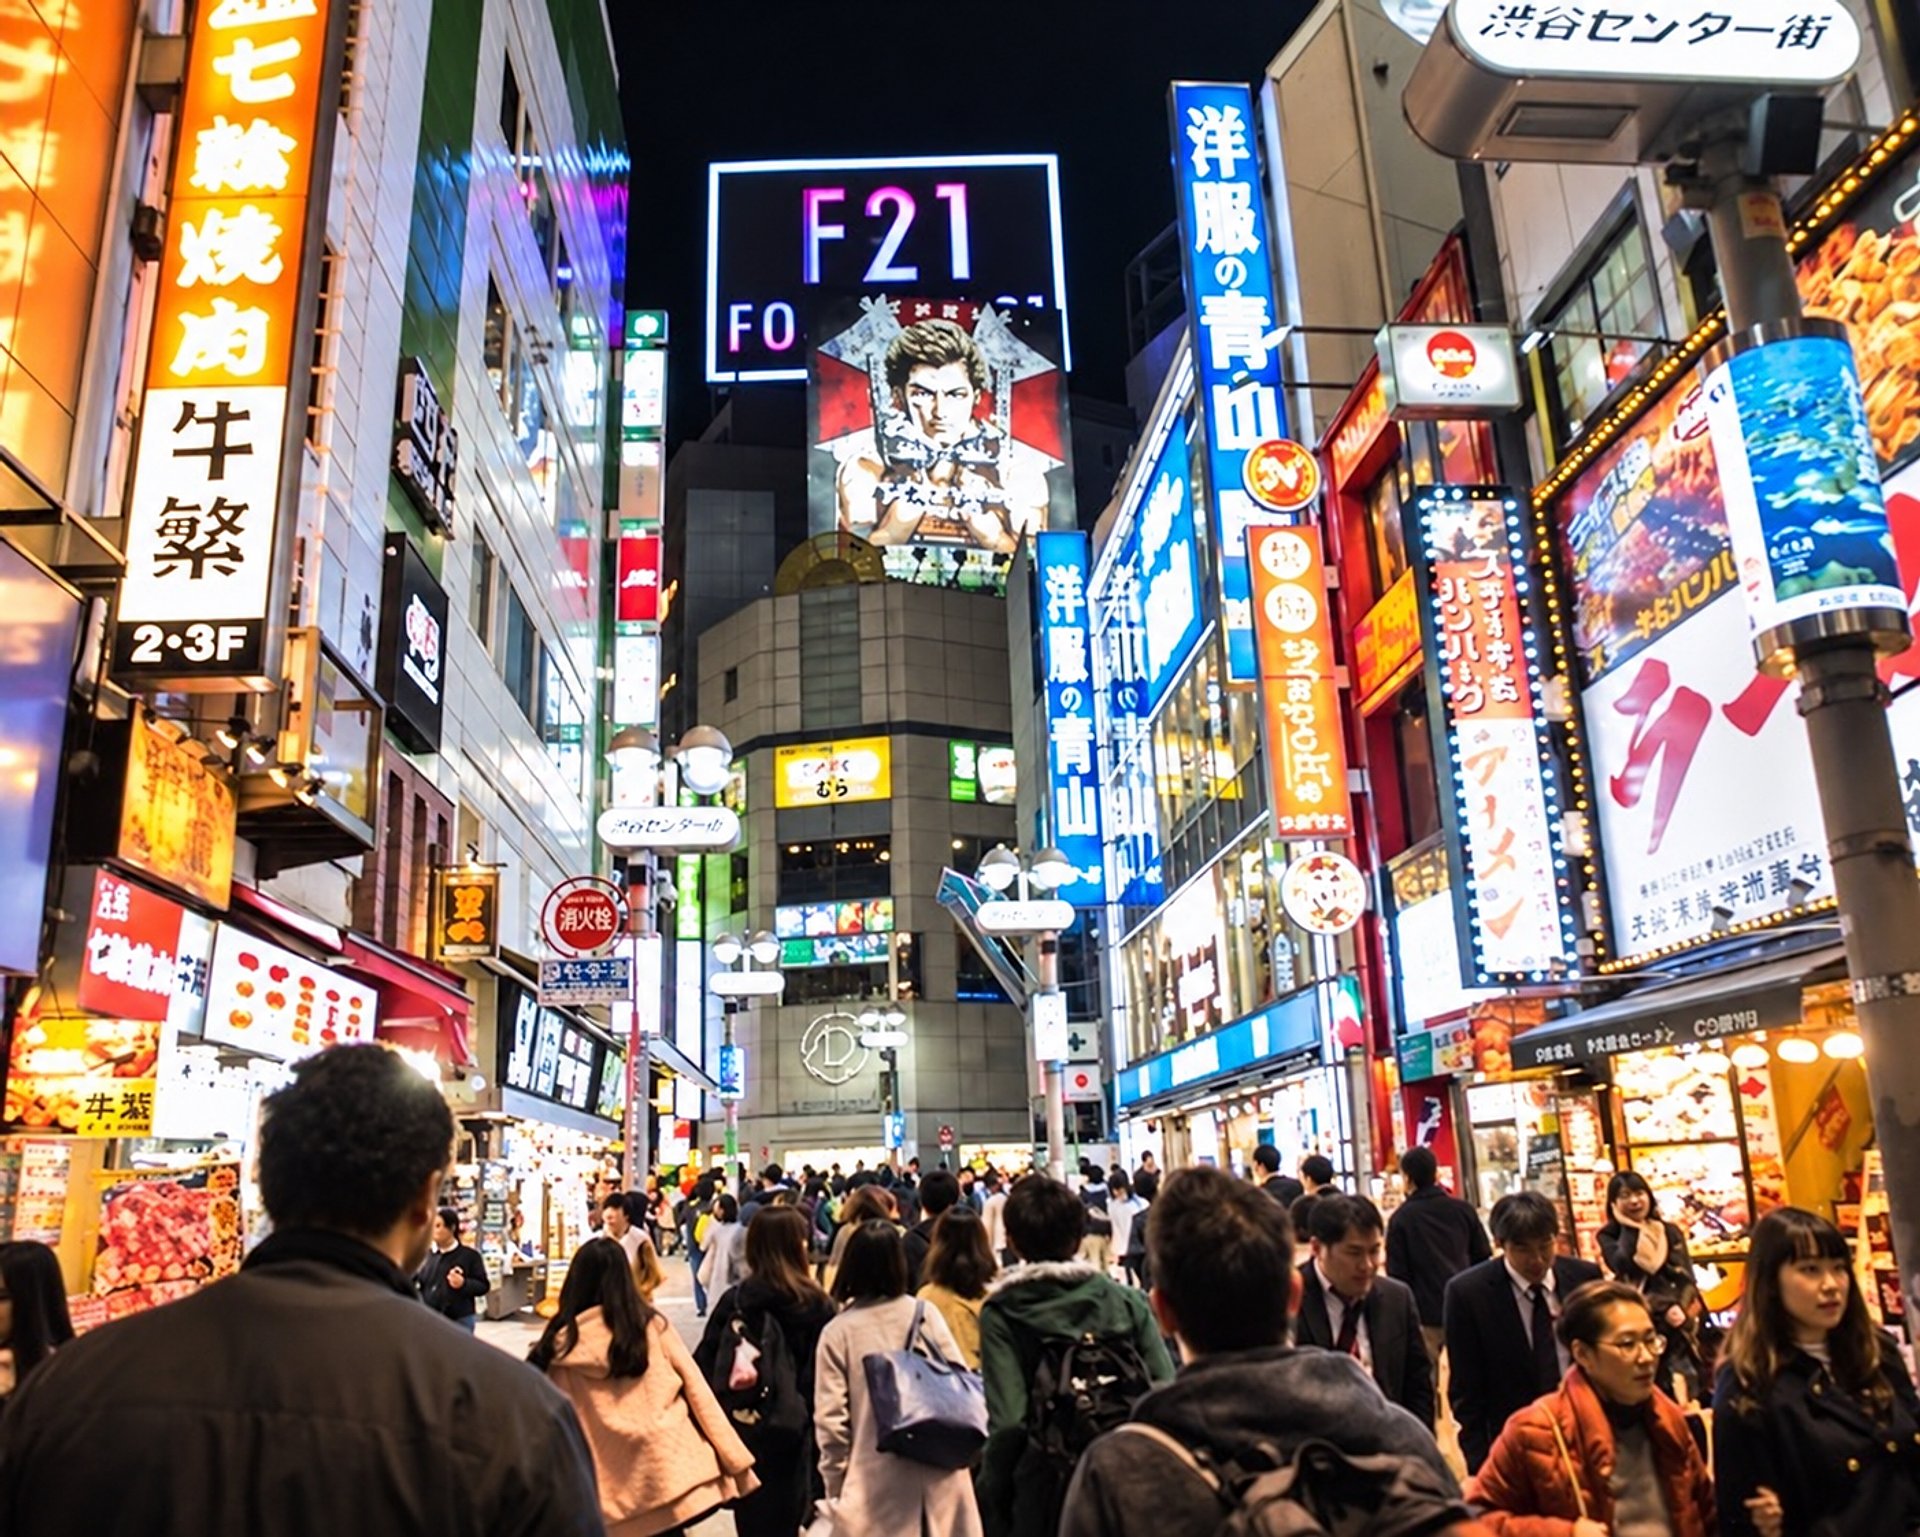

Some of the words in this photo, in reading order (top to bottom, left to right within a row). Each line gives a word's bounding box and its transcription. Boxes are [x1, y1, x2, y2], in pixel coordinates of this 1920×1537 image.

[1479, 4, 1832, 50] 渋谷センター街
[803, 184, 971, 284] F21
[1186, 105, 1280, 451] 洋服の青山
[152, 401, 254, 579] 牛繁
[1046, 564, 1099, 837] 洋服の青山
[560, 906, 613, 932] 消火栓
